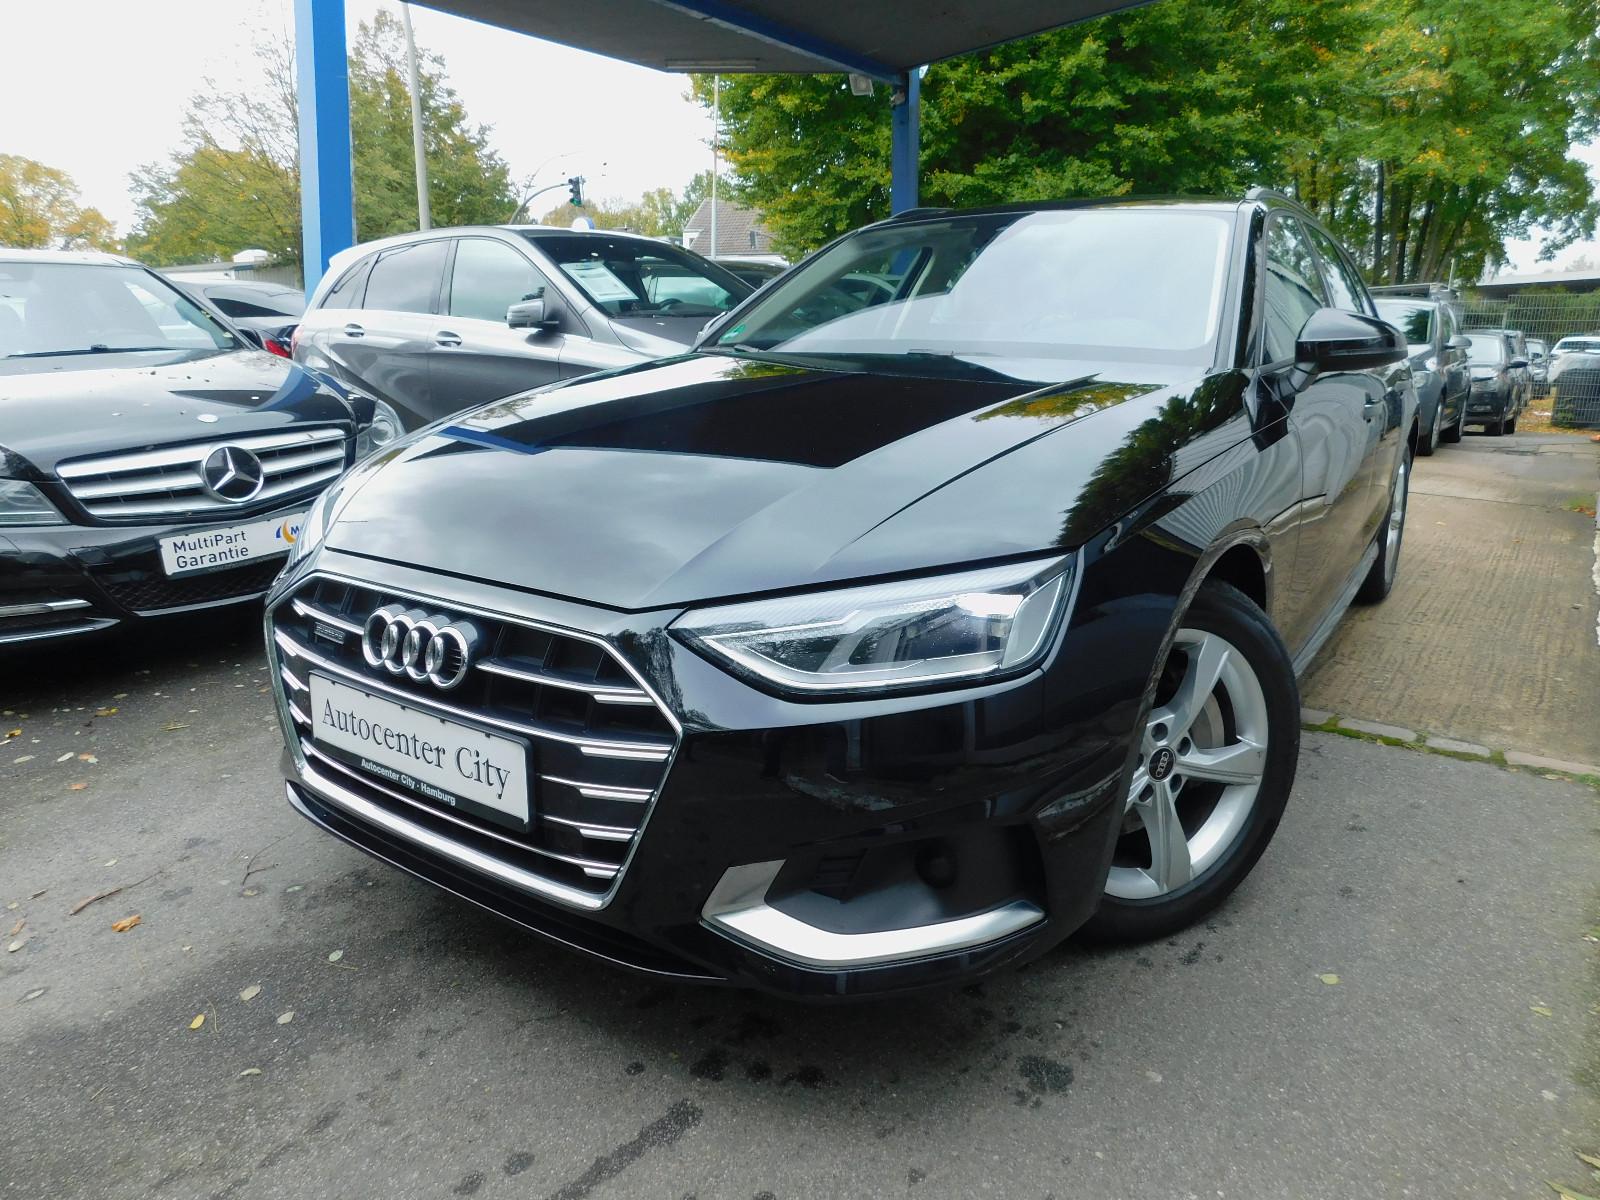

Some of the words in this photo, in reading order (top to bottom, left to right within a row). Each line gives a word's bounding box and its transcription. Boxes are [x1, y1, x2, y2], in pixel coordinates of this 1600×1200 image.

[173, 530, 247, 554] MultiPart
[176, 546, 249, 569] Garantie
[322, 697, 446, 769] Autocenter
[456, 746, 511, 800] City
[360, 758, 400, 781] Autocenter
[400, 774, 416, 790] City
[420, 782, 456, 806] Hamburg
